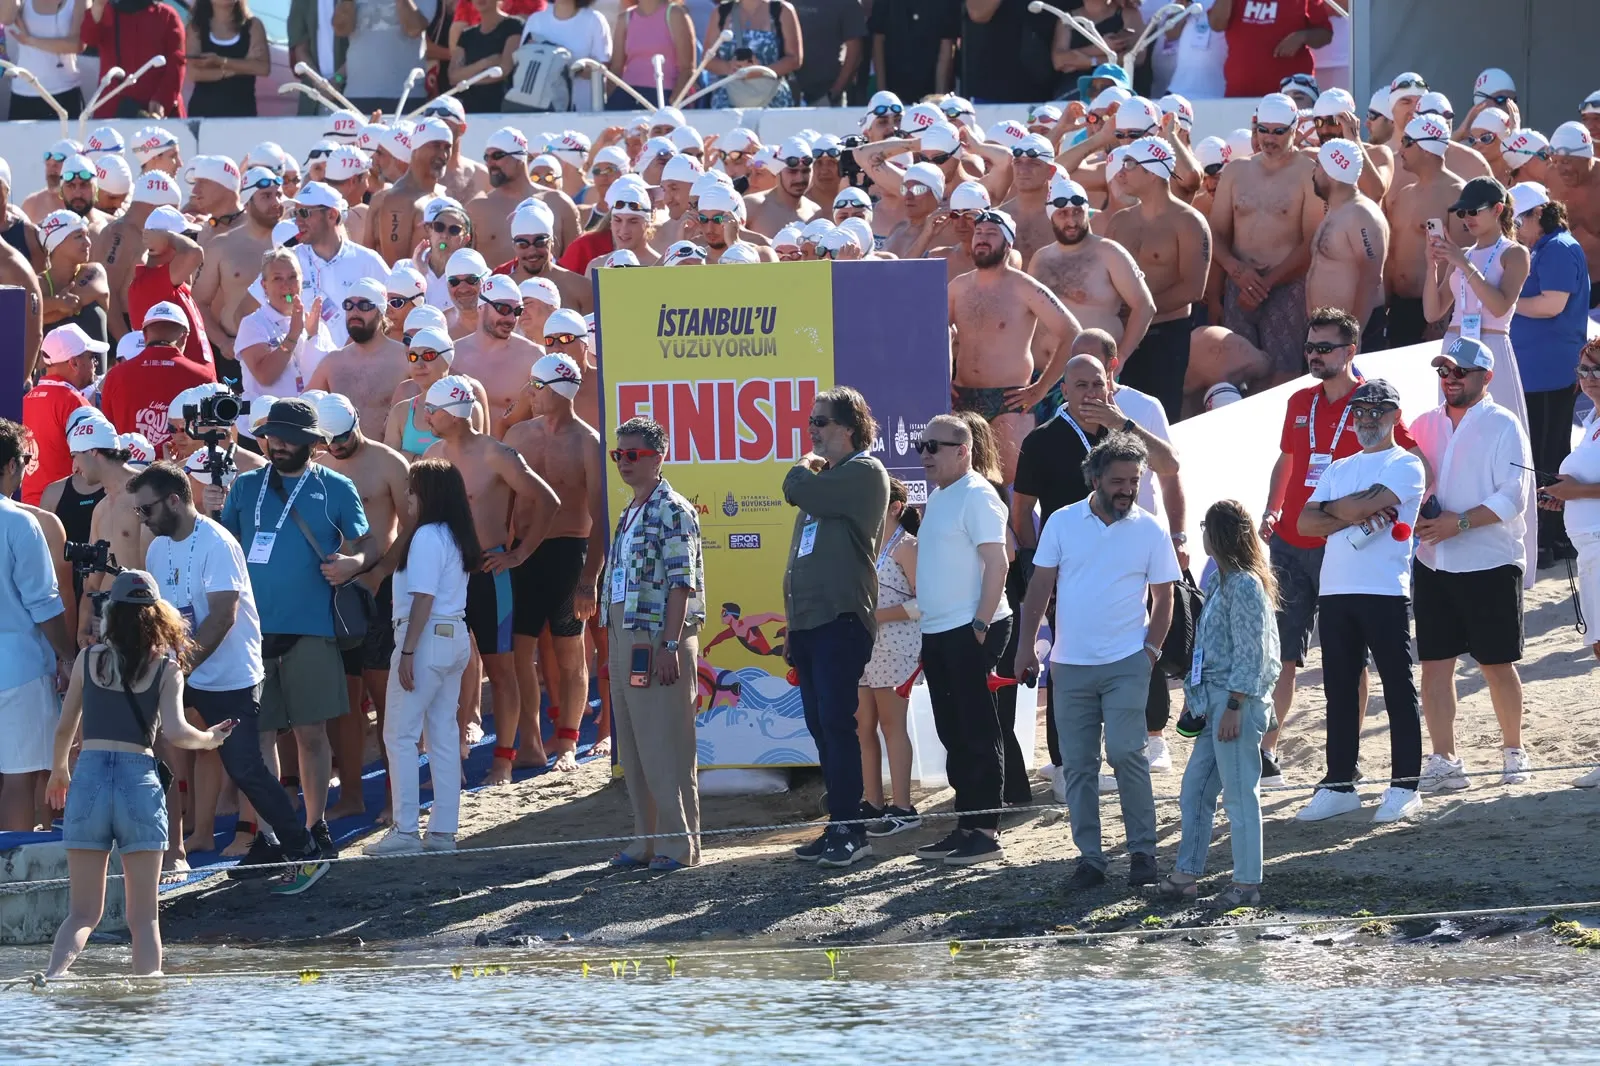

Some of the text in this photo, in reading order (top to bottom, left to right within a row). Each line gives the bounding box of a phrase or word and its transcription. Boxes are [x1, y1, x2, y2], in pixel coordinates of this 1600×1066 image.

[334, 119, 356, 132] 072
[341, 158, 360, 168] 173
[1329, 149, 1351, 171] 333
[146, 179, 169, 192] 318
[656, 303, 777, 337] İSTANBUL'U
[658, 336, 778, 359] YÜZÜYORUM
[615, 377, 818, 465] FINISH
[73, 424, 94, 437] 226
[730, 535, 759, 543] SPOR
